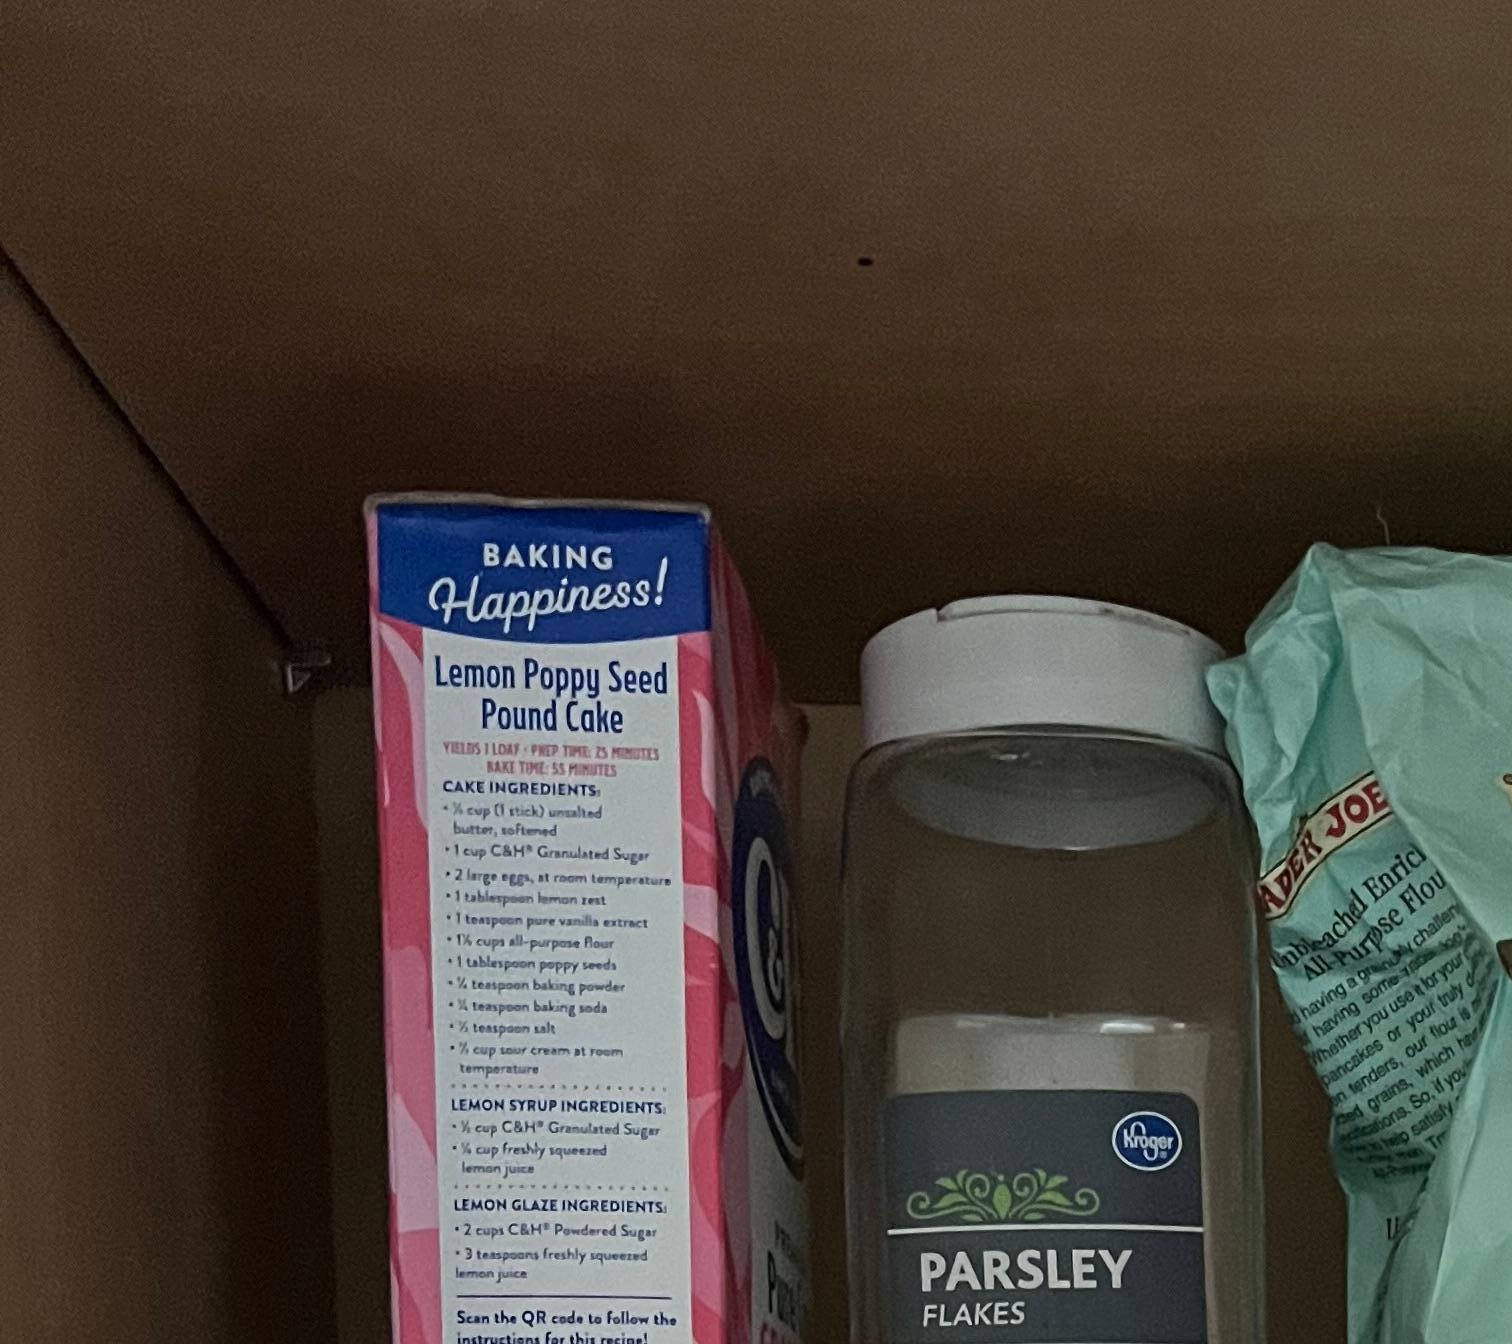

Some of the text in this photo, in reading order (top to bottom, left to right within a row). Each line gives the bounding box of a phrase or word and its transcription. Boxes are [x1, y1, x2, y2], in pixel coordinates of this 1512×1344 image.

[483, 543, 613, 570] BAKING
[428, 556, 668, 633] Happiness!
[434, 655, 668, 698] Lemon Poppy Seed
[481, 698, 624, 734] Pound Cake
[443, 781, 600, 797] CAKE INGREDIENTS:
[1257, 779, 1389, 915] ADER JOE
[455, 869, 671, 888] 2 large eggs, at room temperature
[1400, 870, 1447, 917] Flou
[452, 1099, 666, 1115] LEMON SYRUP INGREDIENTS:
[1123, 1121, 1173, 1161] Kroger
[454, 1199, 668, 1214] LEMON GLAZE INGREDIENTS:
[464, 1224, 471, 1236] 2
[476, 1226, 504, 1238] cups
[554, 1225, 616, 1237] Powdered
[621, 1225, 657, 1241] Sugar
[920, 1249, 1133, 1292] PARSLEY
[457, 1310, 677, 1327] Scan the QR code to follow the
[922, 1301, 1025, 1327] FLAKES
